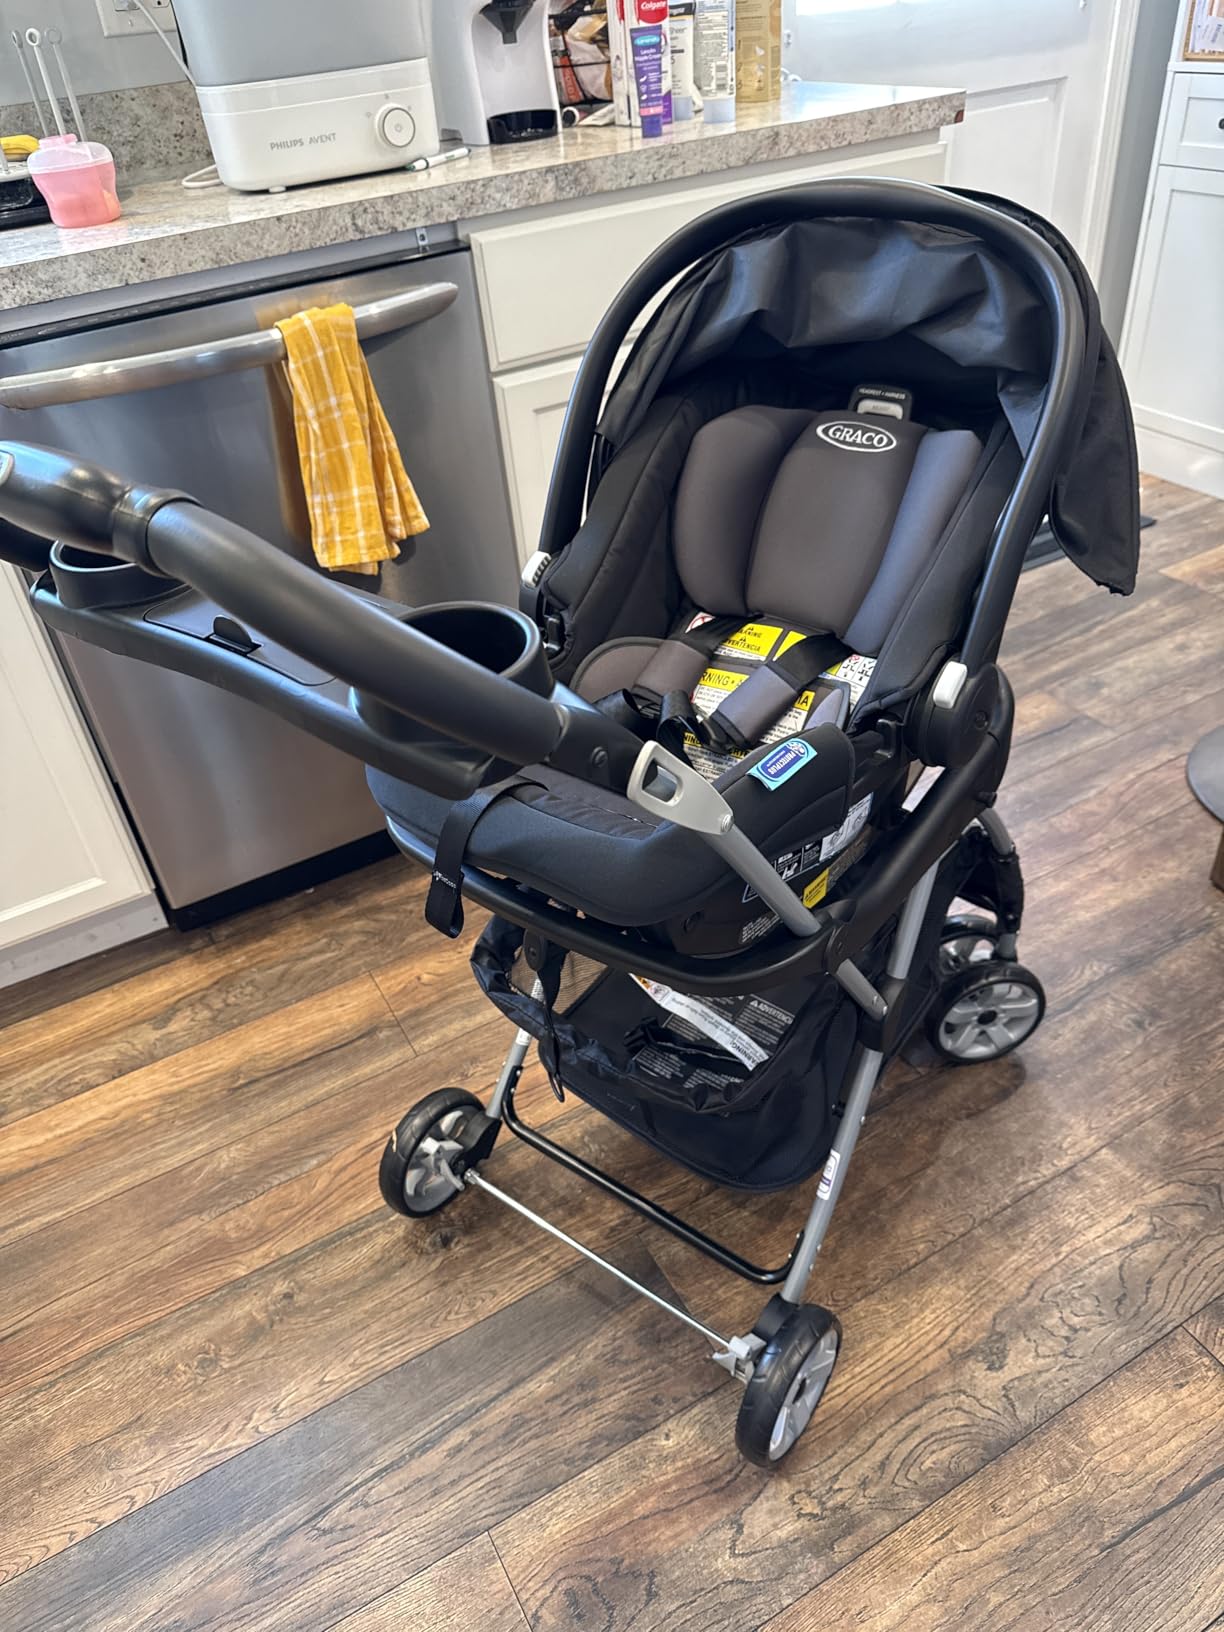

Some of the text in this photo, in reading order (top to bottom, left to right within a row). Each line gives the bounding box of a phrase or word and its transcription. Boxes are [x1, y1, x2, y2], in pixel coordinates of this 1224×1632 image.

[640, 1, 667, 10] Colgate
[269, 132, 336, 151] PHILIPS AVENT
[828, 424, 889, 448] GRACO
[702, 671, 730, 686] RNING
